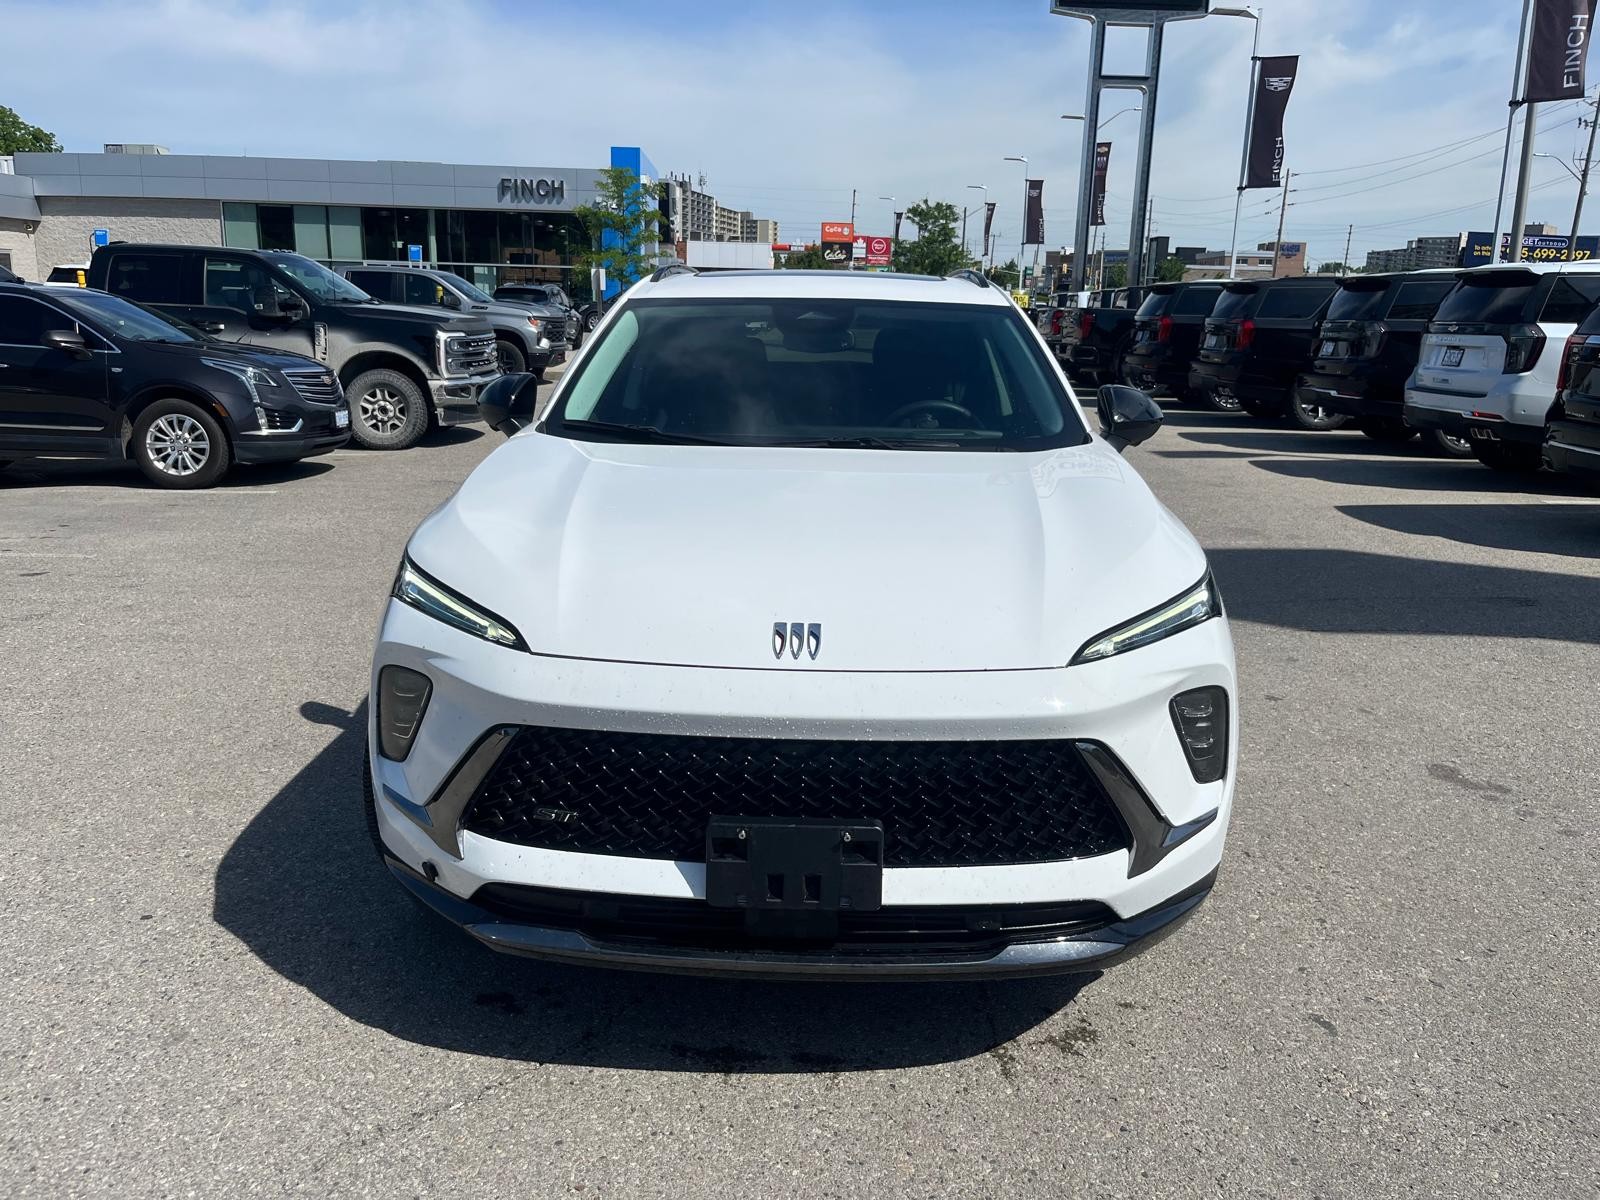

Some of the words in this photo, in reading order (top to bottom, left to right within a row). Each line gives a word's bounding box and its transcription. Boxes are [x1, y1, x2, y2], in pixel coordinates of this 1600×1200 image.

[1563, 14, 1589, 88] FINCH
[1272, 136, 1283, 182] FINCH
[500, 178, 564, 201] FINCH
